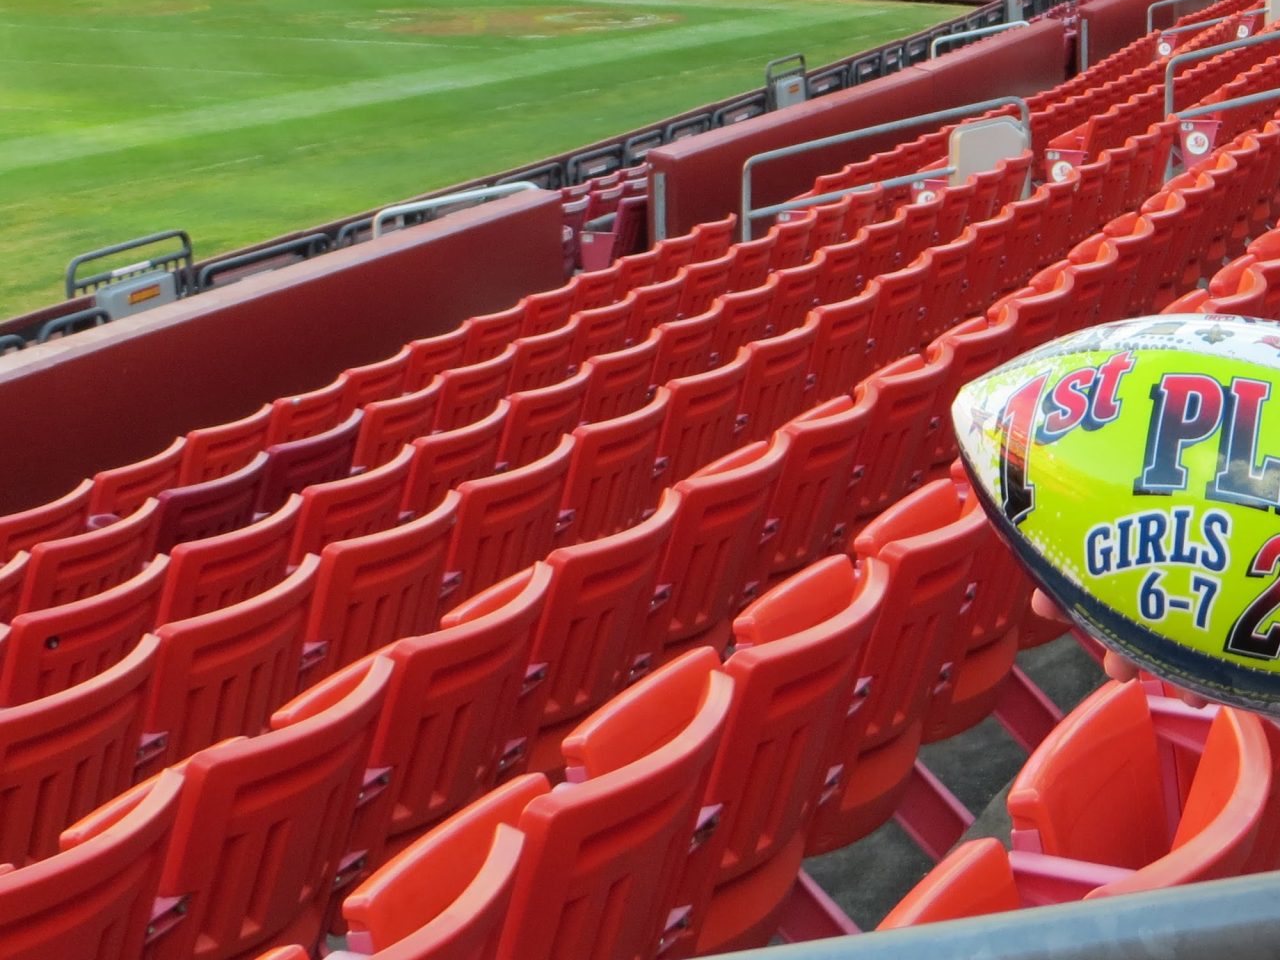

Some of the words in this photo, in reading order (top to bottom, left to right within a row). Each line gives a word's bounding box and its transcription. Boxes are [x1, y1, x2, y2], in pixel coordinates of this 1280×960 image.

[999, 350, 1138, 528] 1st
[1085, 504, 1232, 578] GIRLS
[1138, 569, 1222, 632] 6-7
